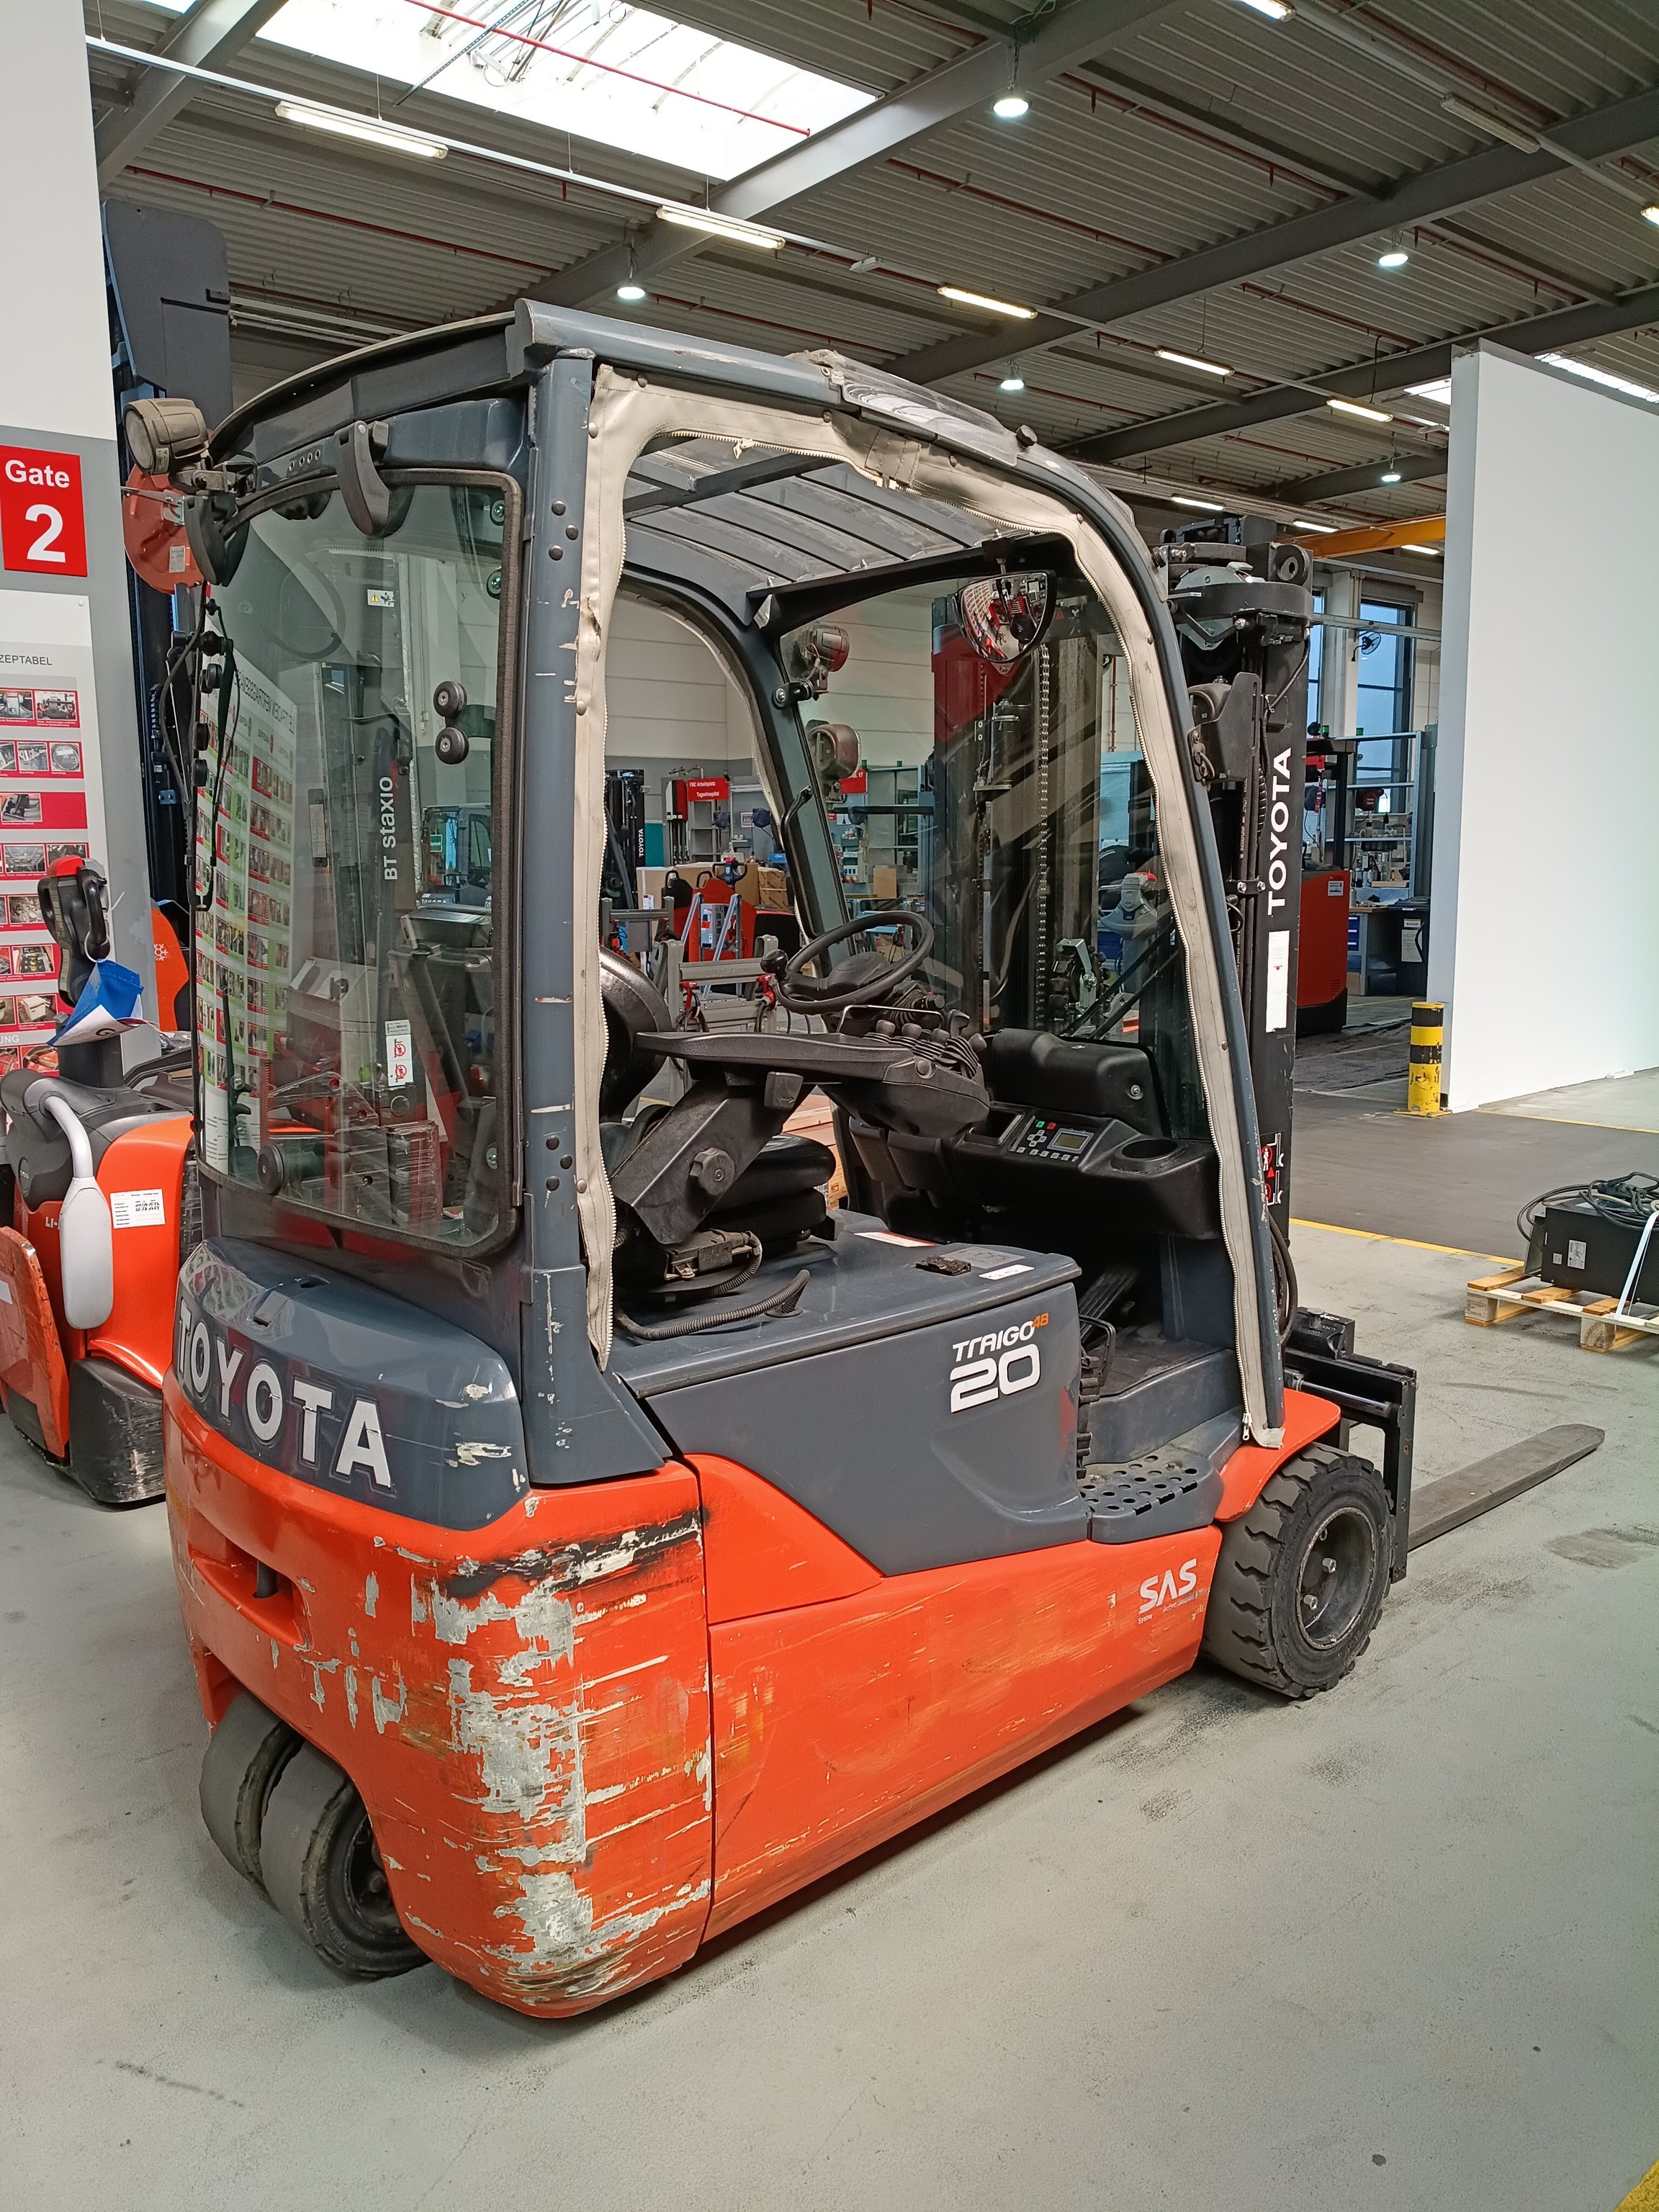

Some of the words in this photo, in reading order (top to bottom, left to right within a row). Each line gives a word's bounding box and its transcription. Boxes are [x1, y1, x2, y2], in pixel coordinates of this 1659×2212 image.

[5, 459, 70, 488] Gate
[24, 504, 66, 563] 2
[1267, 747, 1292, 916] TOYOTA
[384, 855, 398, 880] BT
[953, 1321, 1035, 1362] TRAIGO
[1031, 1313, 1050, 1328] 48
[179, 1297, 391, 1488] TOYOTA
[950, 1344, 1040, 1413] 20
[1138, 1558, 1197, 1615] SAS
